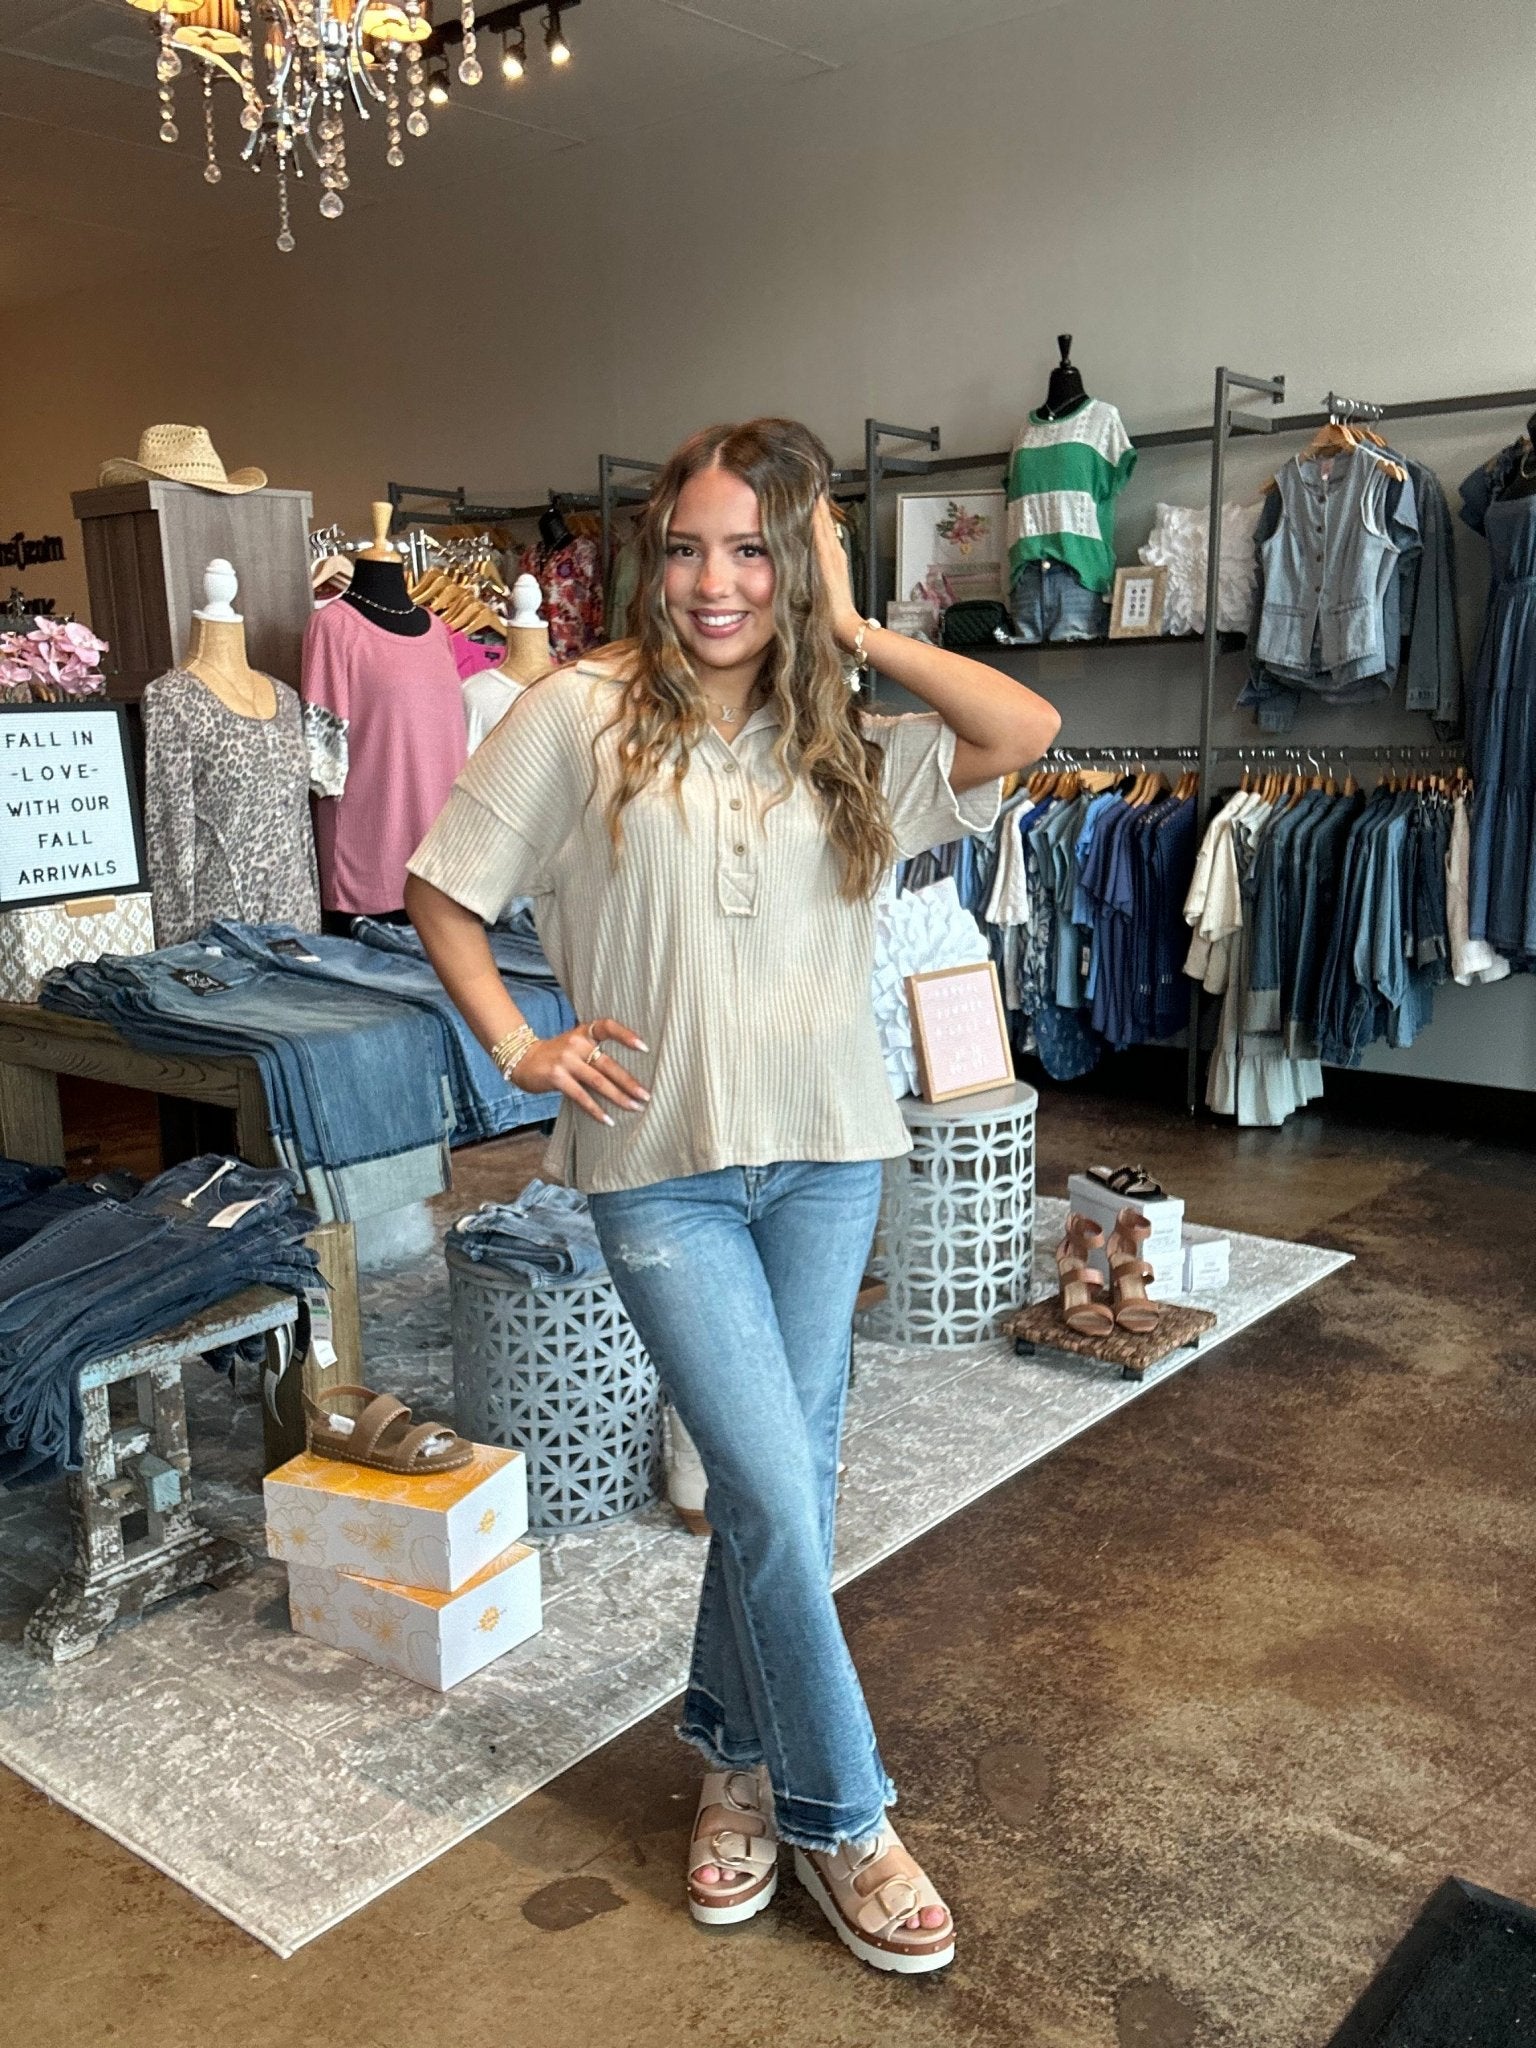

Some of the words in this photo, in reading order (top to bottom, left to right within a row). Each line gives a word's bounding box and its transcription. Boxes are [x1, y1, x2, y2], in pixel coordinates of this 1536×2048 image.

[4, 731, 62, 749] FALL
[72, 730, 94, 746] IN
[10, 763, 99, 783] -LOVE-
[5, 798, 60, 818] WITH
[70, 795, 110, 813] OUR
[38, 829, 93, 849] FALL
[18, 859, 117, 886] ARRIVALS
